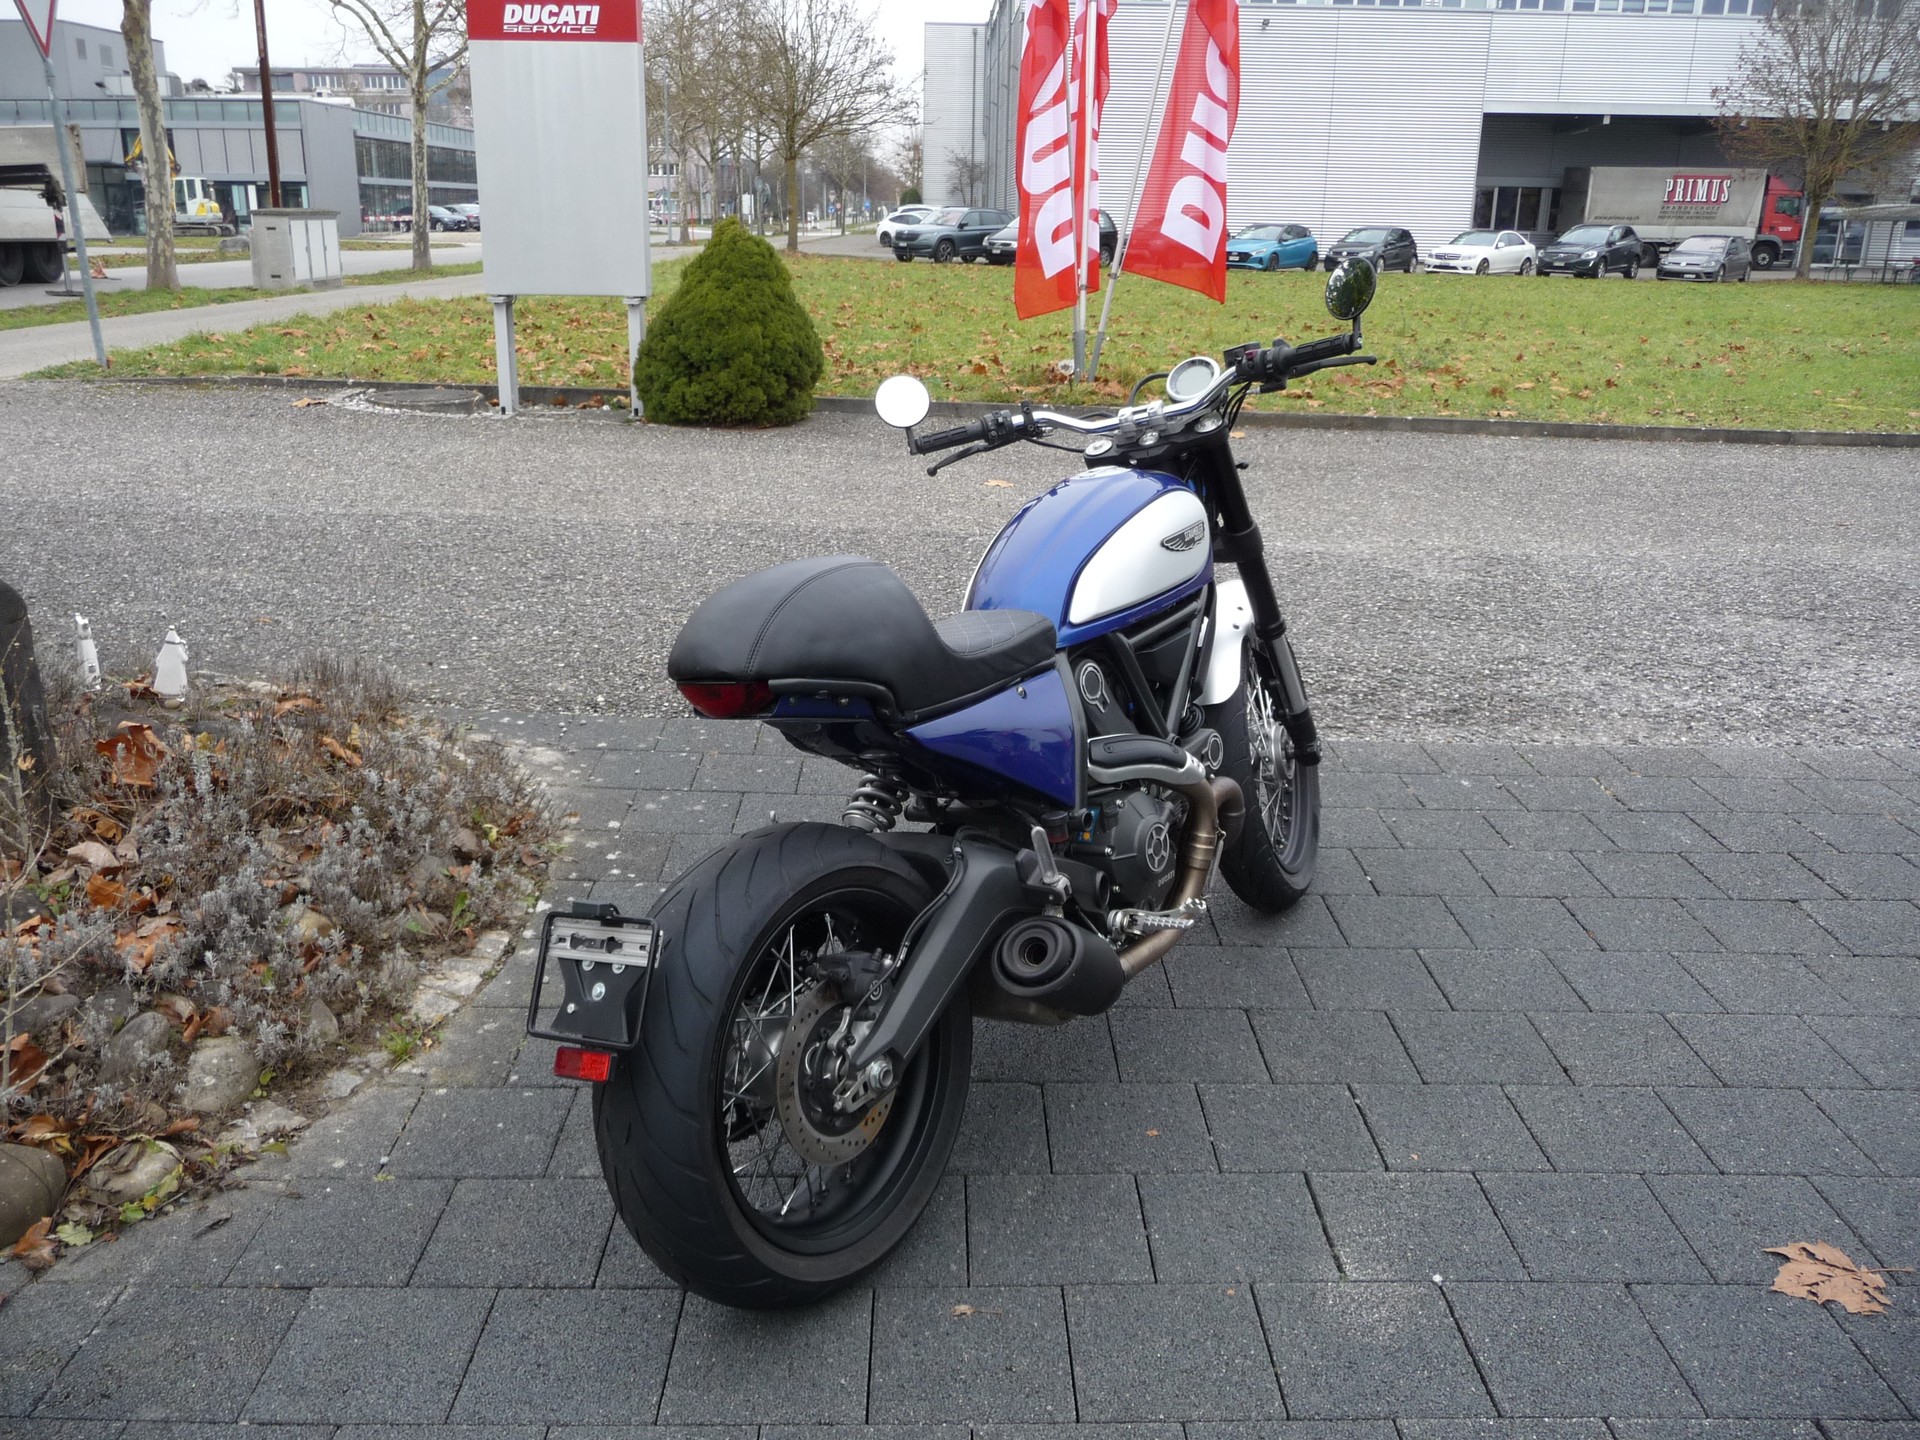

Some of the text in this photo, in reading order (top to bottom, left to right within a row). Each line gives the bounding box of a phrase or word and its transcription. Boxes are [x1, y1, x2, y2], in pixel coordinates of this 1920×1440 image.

[503, 4, 600, 25] DUCATI
[503, 25, 597, 34] SERVICE
[1663, 178, 1731, 203] PRIMUS
